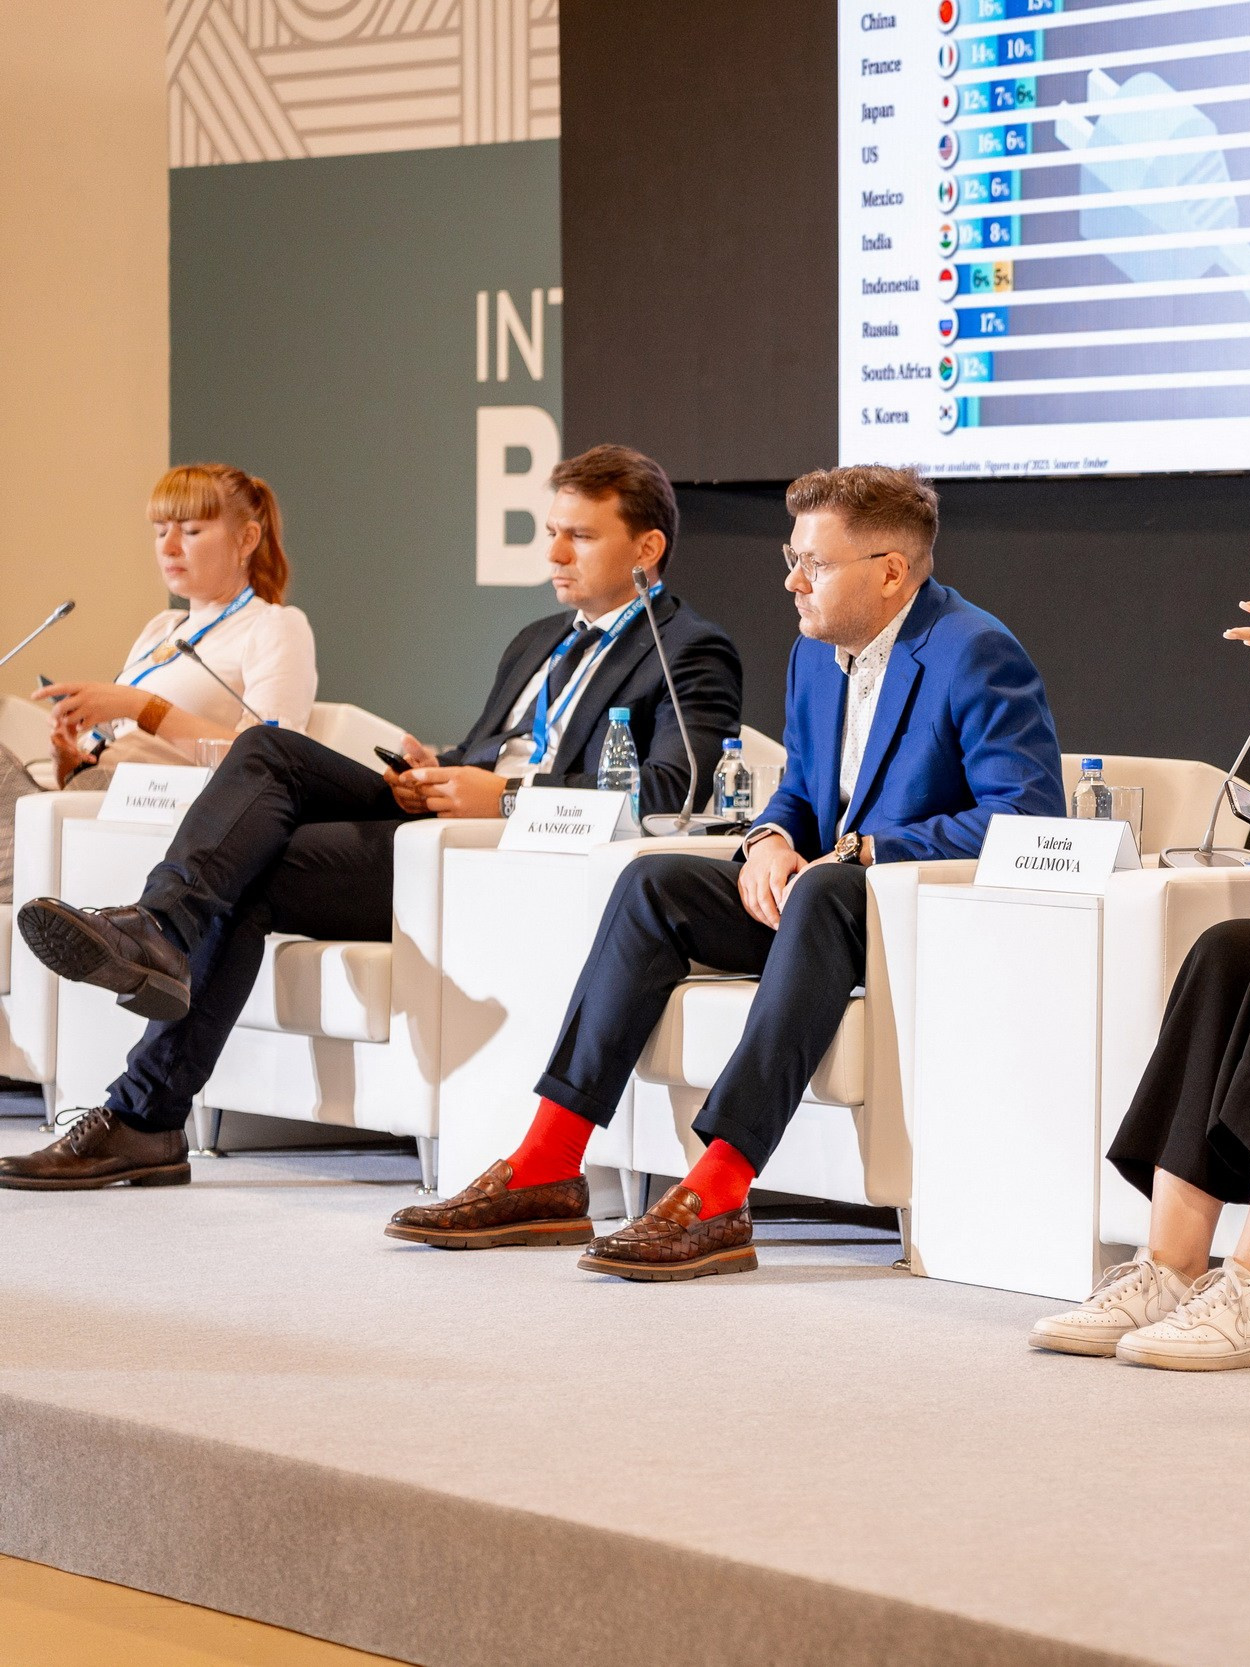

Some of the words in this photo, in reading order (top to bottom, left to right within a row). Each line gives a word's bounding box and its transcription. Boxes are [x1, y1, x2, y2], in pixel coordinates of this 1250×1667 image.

[861, 13, 897, 32] China
[971, 43, 996, 64] 14%
[1007, 37, 1034, 60] 10%
[861, 58, 902, 76] France
[963, 89, 989, 111] 12%
[995, 86, 1015, 106] 7%
[1016, 84, 1034, 102] 6%
[861, 103, 895, 125] Japan
[978, 132, 1003, 154] 16%
[1005, 130, 1026, 151] 6%
[861, 146, 879, 164] US
[964, 179, 988, 199] 12%
[991, 177, 1010, 197] 6%
[861, 189, 904, 208] Mexico
[989, 222, 1010, 242] 8%
[861, 233, 893, 251] India
[861, 275, 920, 295] Indonesia
[972, 269, 990, 288] 6%
[993, 268, 1010, 287] 5%
[861, 320, 899, 338] Russia
[980, 312, 1005, 334] 17%
[476, 287, 563, 382] IN
[861, 362, 895, 382] South
[898, 362, 932, 380] Africa
[861, 408, 871, 425] S.
[875, 407, 909, 424] Korea
[148, 781, 169, 792] Pavel
[554, 805, 583, 818] Maxim
[528, 821, 593, 836] KANISHCHEV
[1037, 835, 1073, 851] Valeria
[1015, 855, 1080, 873] GULIMOVA
